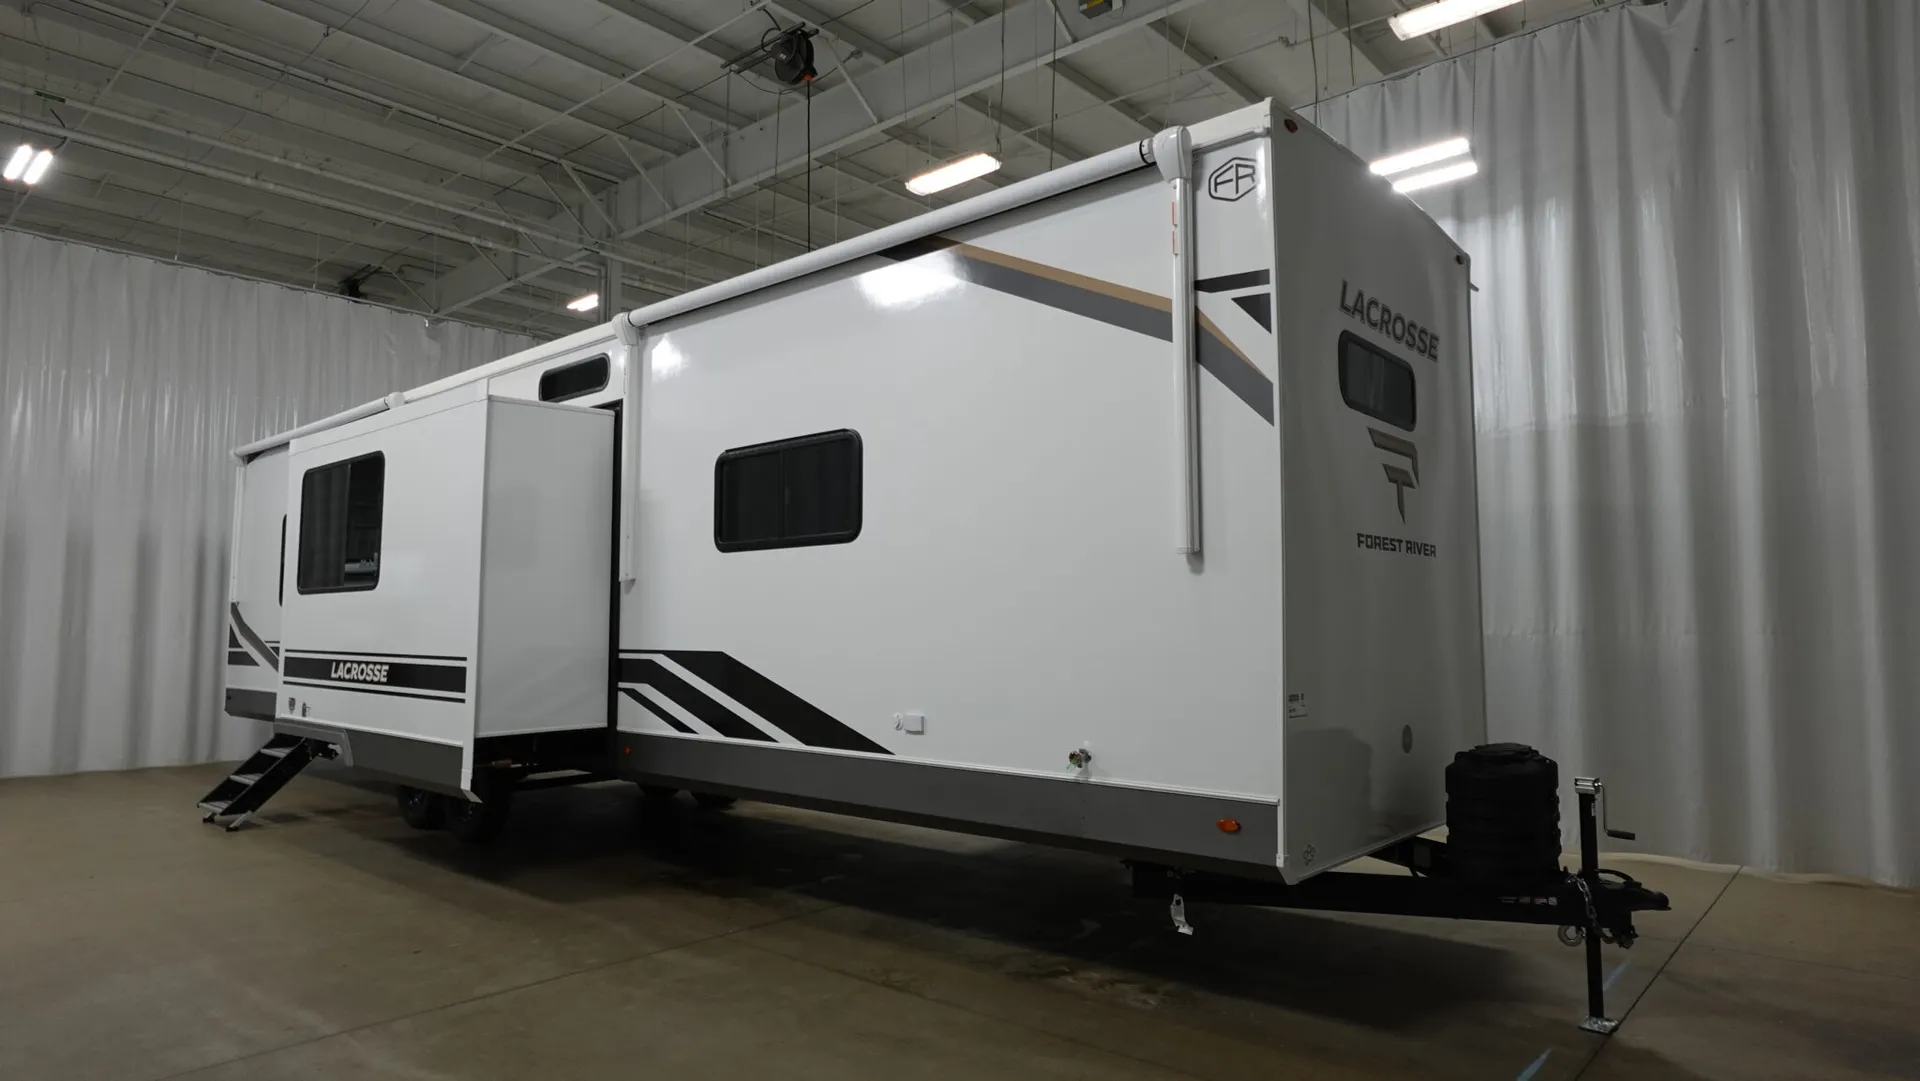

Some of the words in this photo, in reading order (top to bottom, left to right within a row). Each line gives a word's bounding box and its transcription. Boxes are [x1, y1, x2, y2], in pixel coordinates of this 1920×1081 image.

[1340, 279, 1440, 363] LACROSSE
[1356, 532, 1403, 552] FOREST
[1405, 540, 1437, 558] RIVER
[330, 661, 390, 683] LACROSSE
